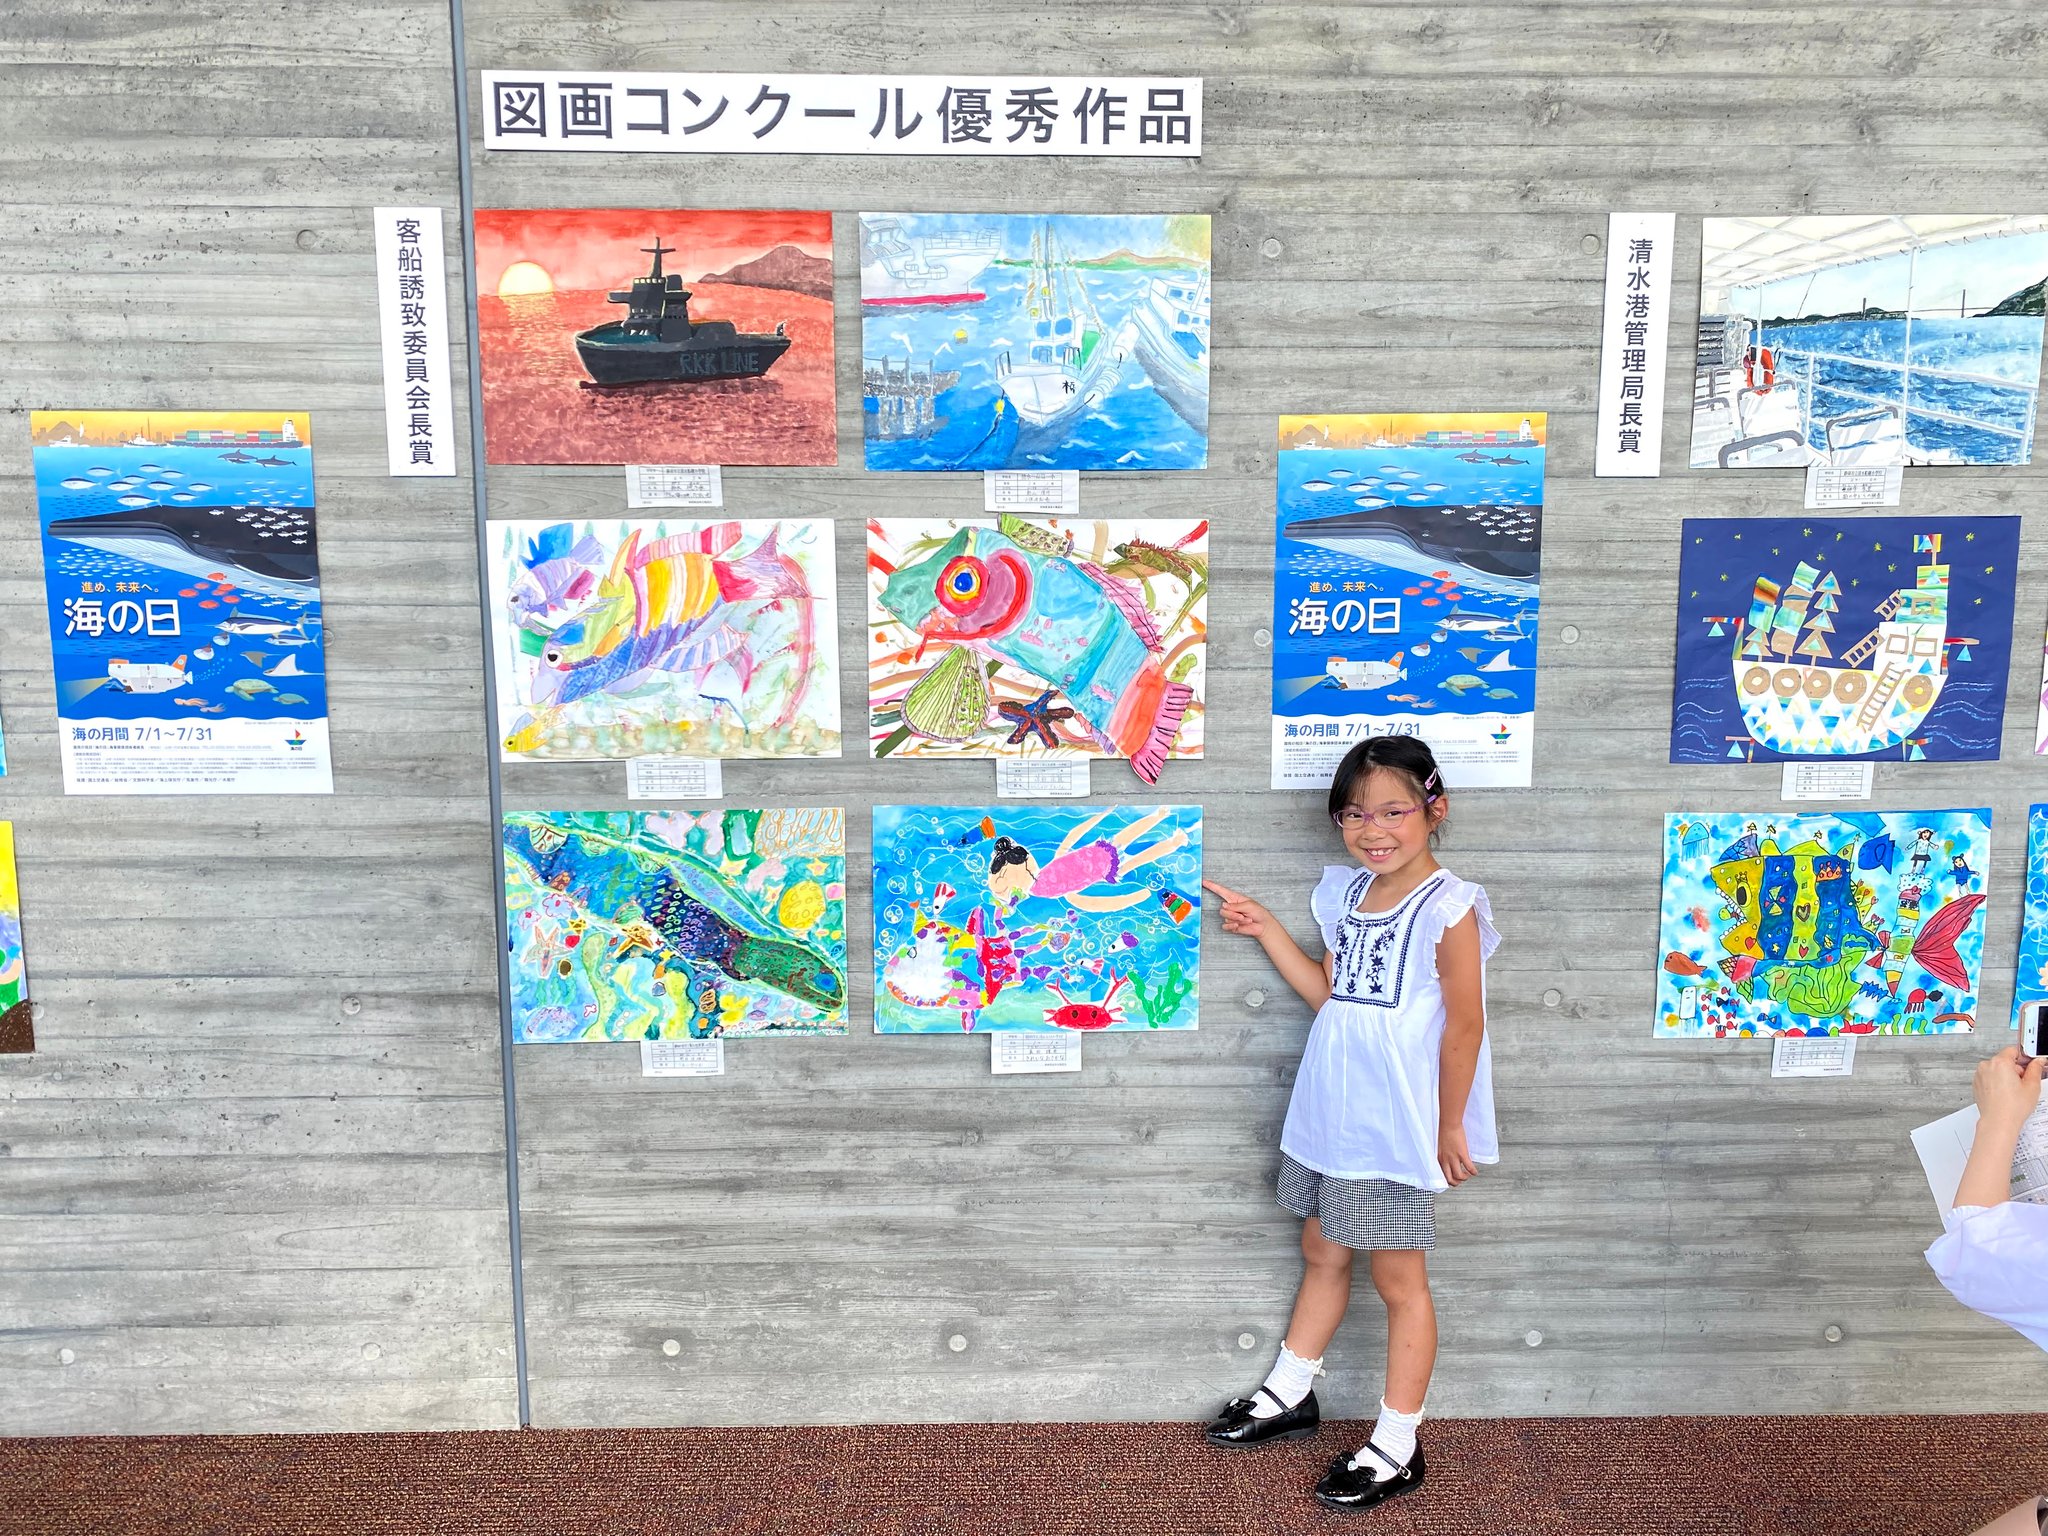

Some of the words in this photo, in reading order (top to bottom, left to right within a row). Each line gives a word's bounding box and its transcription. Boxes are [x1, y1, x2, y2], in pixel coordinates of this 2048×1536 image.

[492, 81, 1191, 144] 図画コンクール優秀作品
[395, 218, 434, 465] 客船誘致委員会長賞
[1617, 238, 1653, 454] 清水港管理局長賞
[680, 352, 718, 375] RKK
[720, 351, 759, 373] LINE
[81, 581, 159, 593] 進め、未来へ。
[1309, 581, 1384, 593] 進め、未来へ。
[63, 597, 181, 637] 海の日
[1288, 597, 1401, 636] 海の日
[72, 727, 129, 741] 海の月間
[1284, 723, 1340, 737] 海の月間
